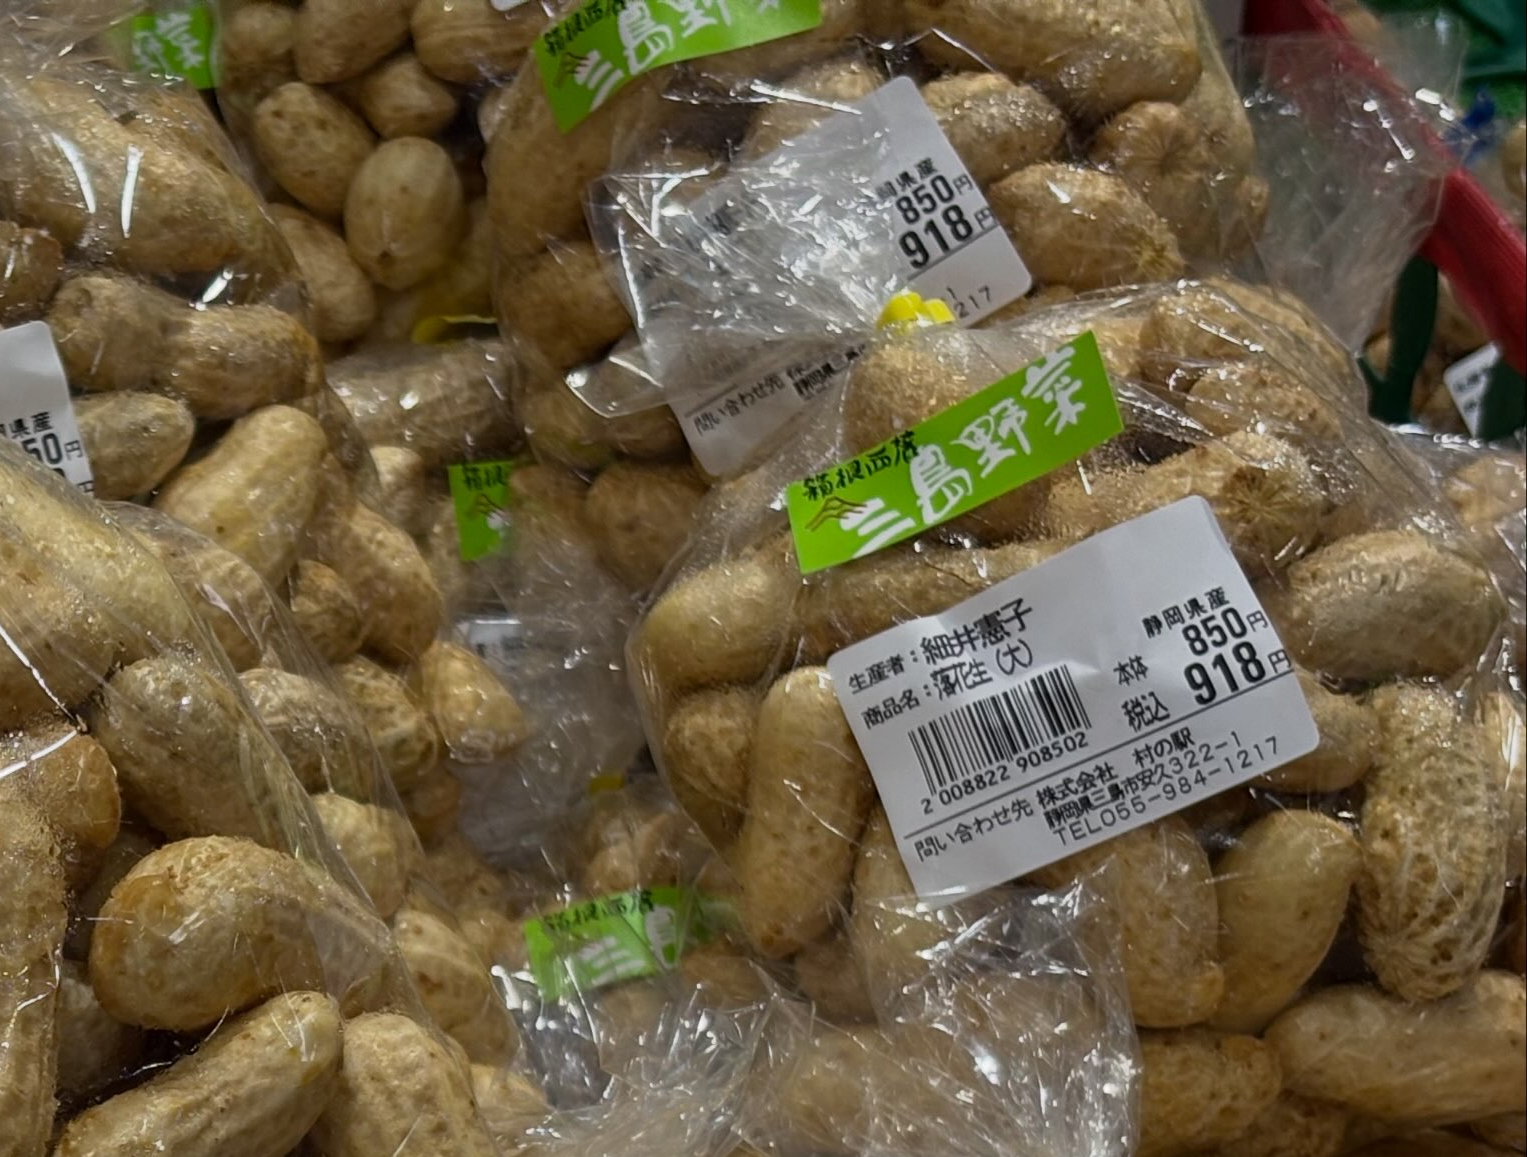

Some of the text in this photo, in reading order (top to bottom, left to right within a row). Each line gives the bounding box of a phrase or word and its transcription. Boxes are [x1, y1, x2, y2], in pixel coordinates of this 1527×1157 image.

[896, 173, 974, 227] 850円
[898, 203, 994, 269] 918円
[840, 347, 1086, 559] 三島野菜
[1141, 586, 1229, 638] 静岡県産
[1113, 655, 1149, 687] 本体
[1122, 691, 1171, 733] 税込
[914, 726, 1195, 862] 問い合わせ先 株式会社 村の駅
[922, 731, 1089, 815] 2 008822 908502
[1053, 735, 1280, 846] TEL055-984-1217
